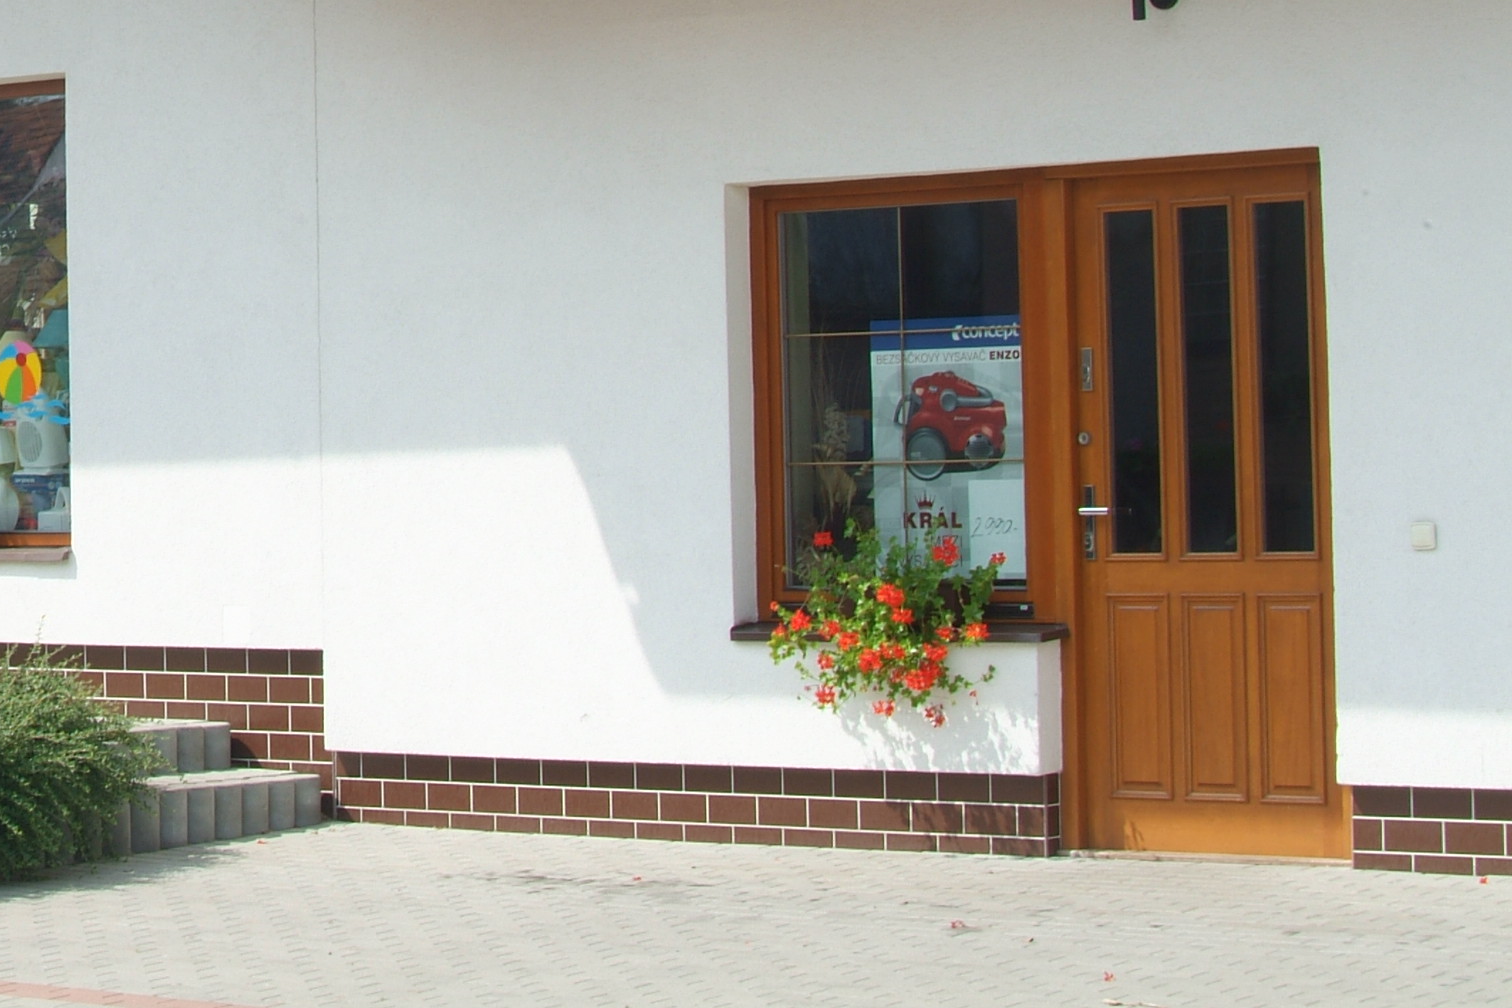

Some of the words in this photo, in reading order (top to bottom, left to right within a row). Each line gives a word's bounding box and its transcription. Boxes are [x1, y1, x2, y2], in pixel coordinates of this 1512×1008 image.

[962, 323, 1020, 339] concept
[989, 350, 1020, 361] ENZO
[903, 506, 963, 529] KRÁL
